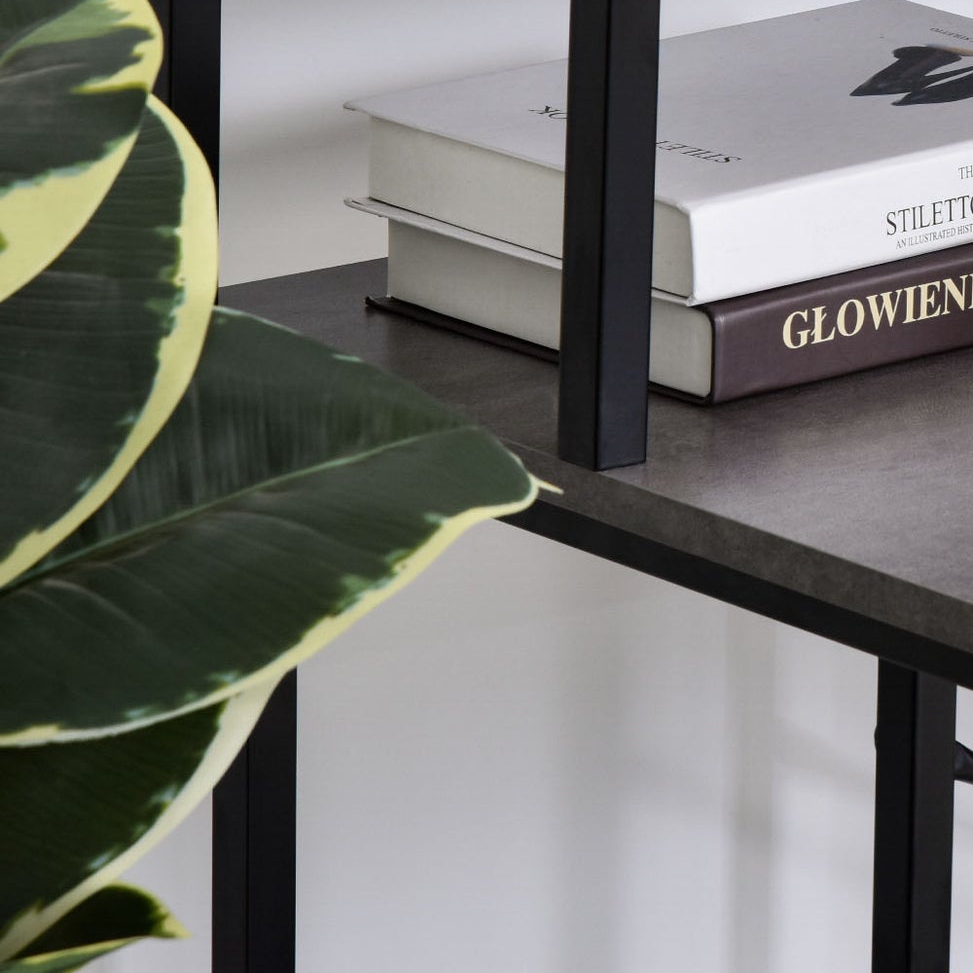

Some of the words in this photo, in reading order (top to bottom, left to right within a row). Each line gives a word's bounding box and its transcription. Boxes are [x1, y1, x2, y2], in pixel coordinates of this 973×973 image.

[528, 105, 567, 120] OK
[656, 140, 742, 164] STILET
[895, 238, 908, 250] AN
[908, 228, 957, 247] ILLUSTRATED
